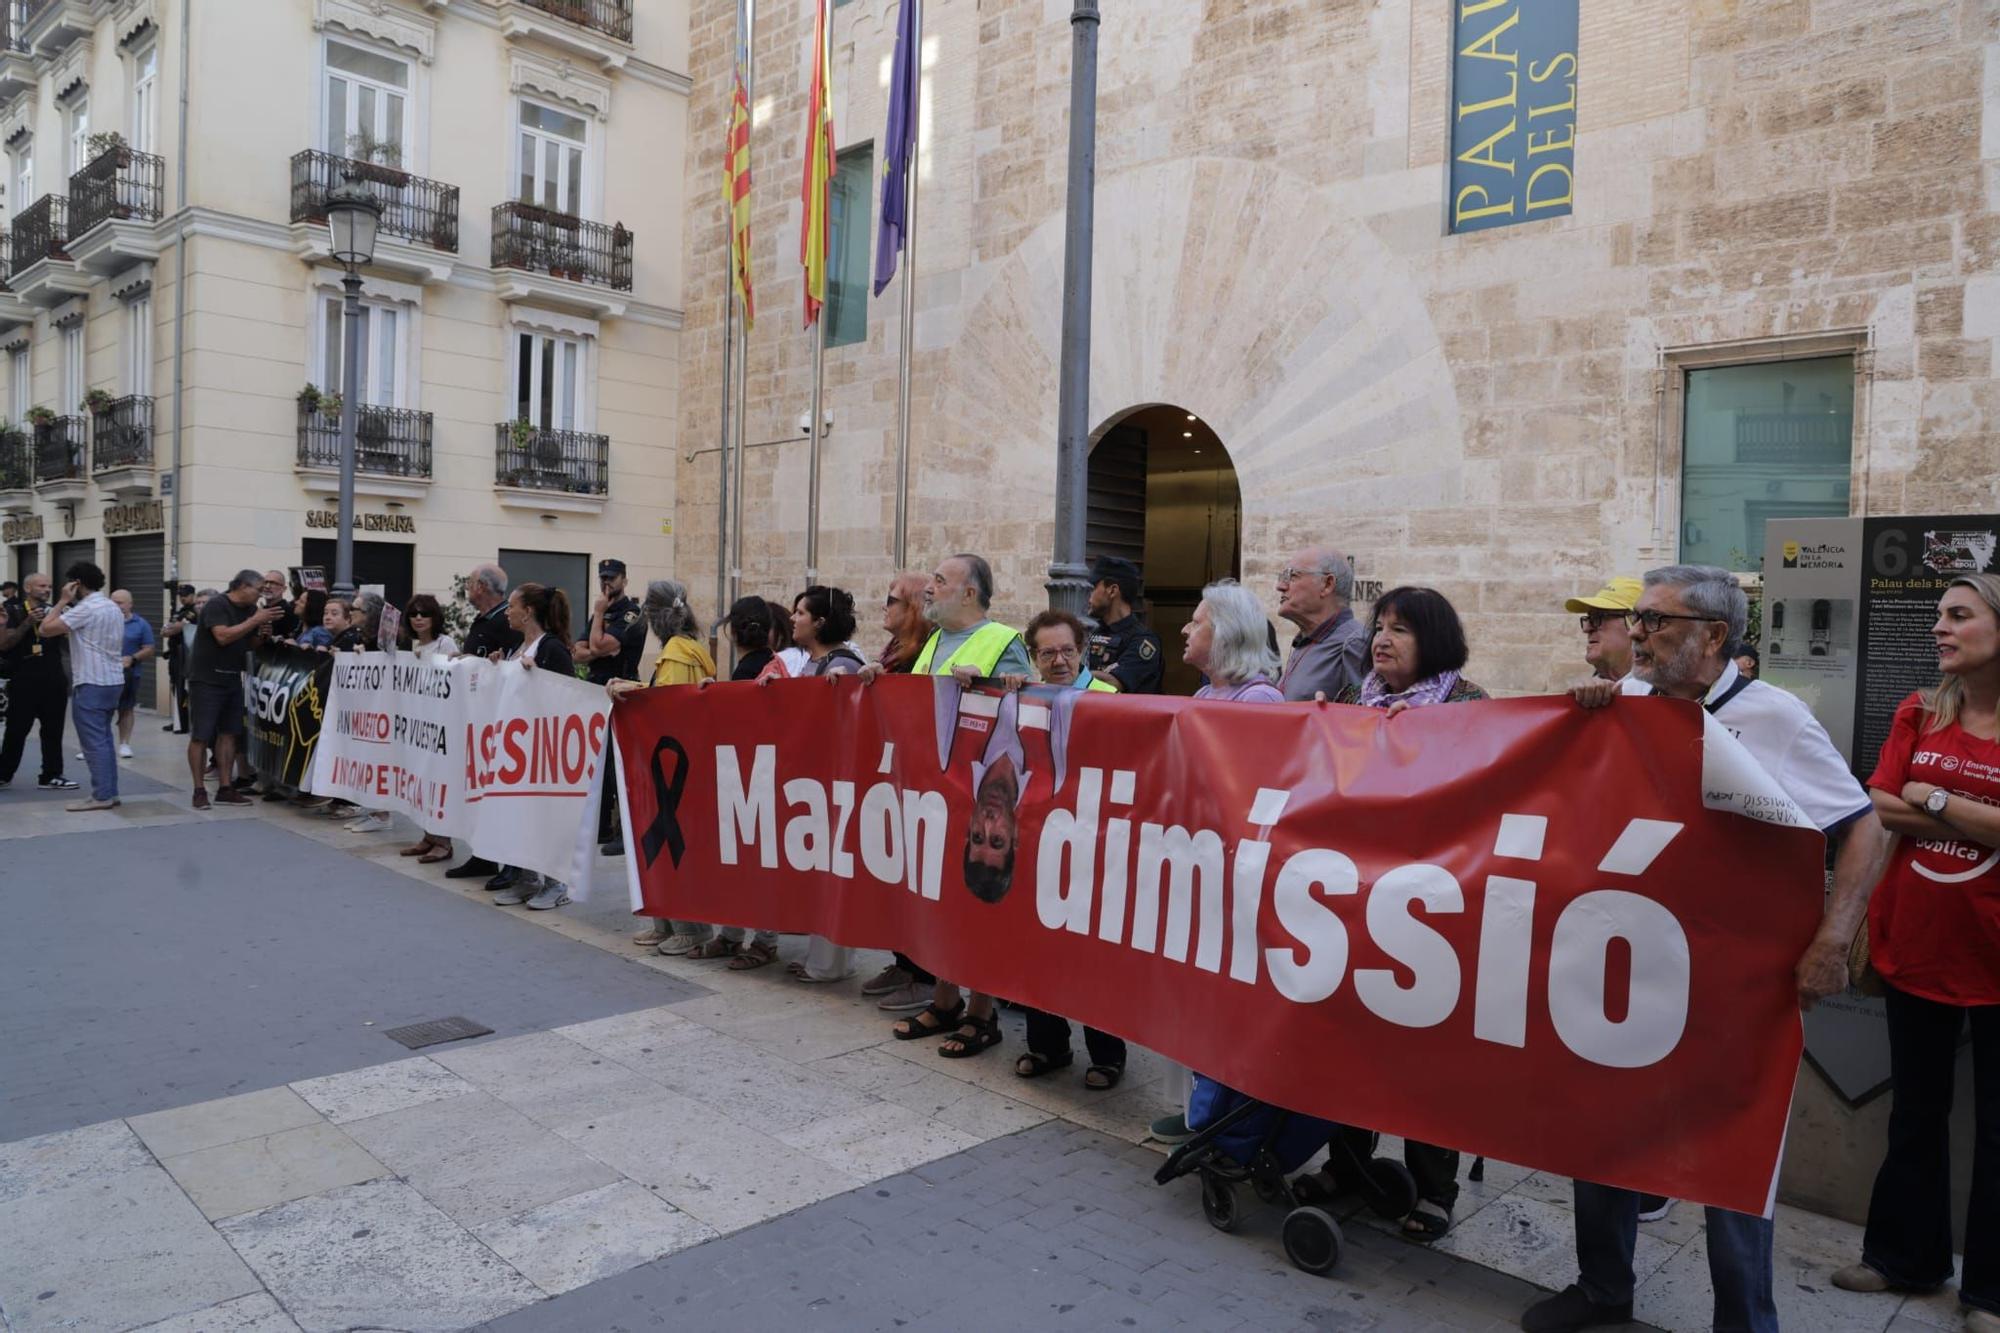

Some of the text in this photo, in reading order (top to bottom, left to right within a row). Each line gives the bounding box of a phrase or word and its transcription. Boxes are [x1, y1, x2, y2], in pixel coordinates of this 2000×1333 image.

[1526, 52, 1577, 215] DELS
[1871, 579, 1951, 588] Palau dels Bo
[409, 718, 447, 755] VUESTRA
[465, 712, 606, 791] ASESINOS
[1912, 752, 1942, 766] UGT
[715, 742, 1691, 1068] Mazón dimissió
